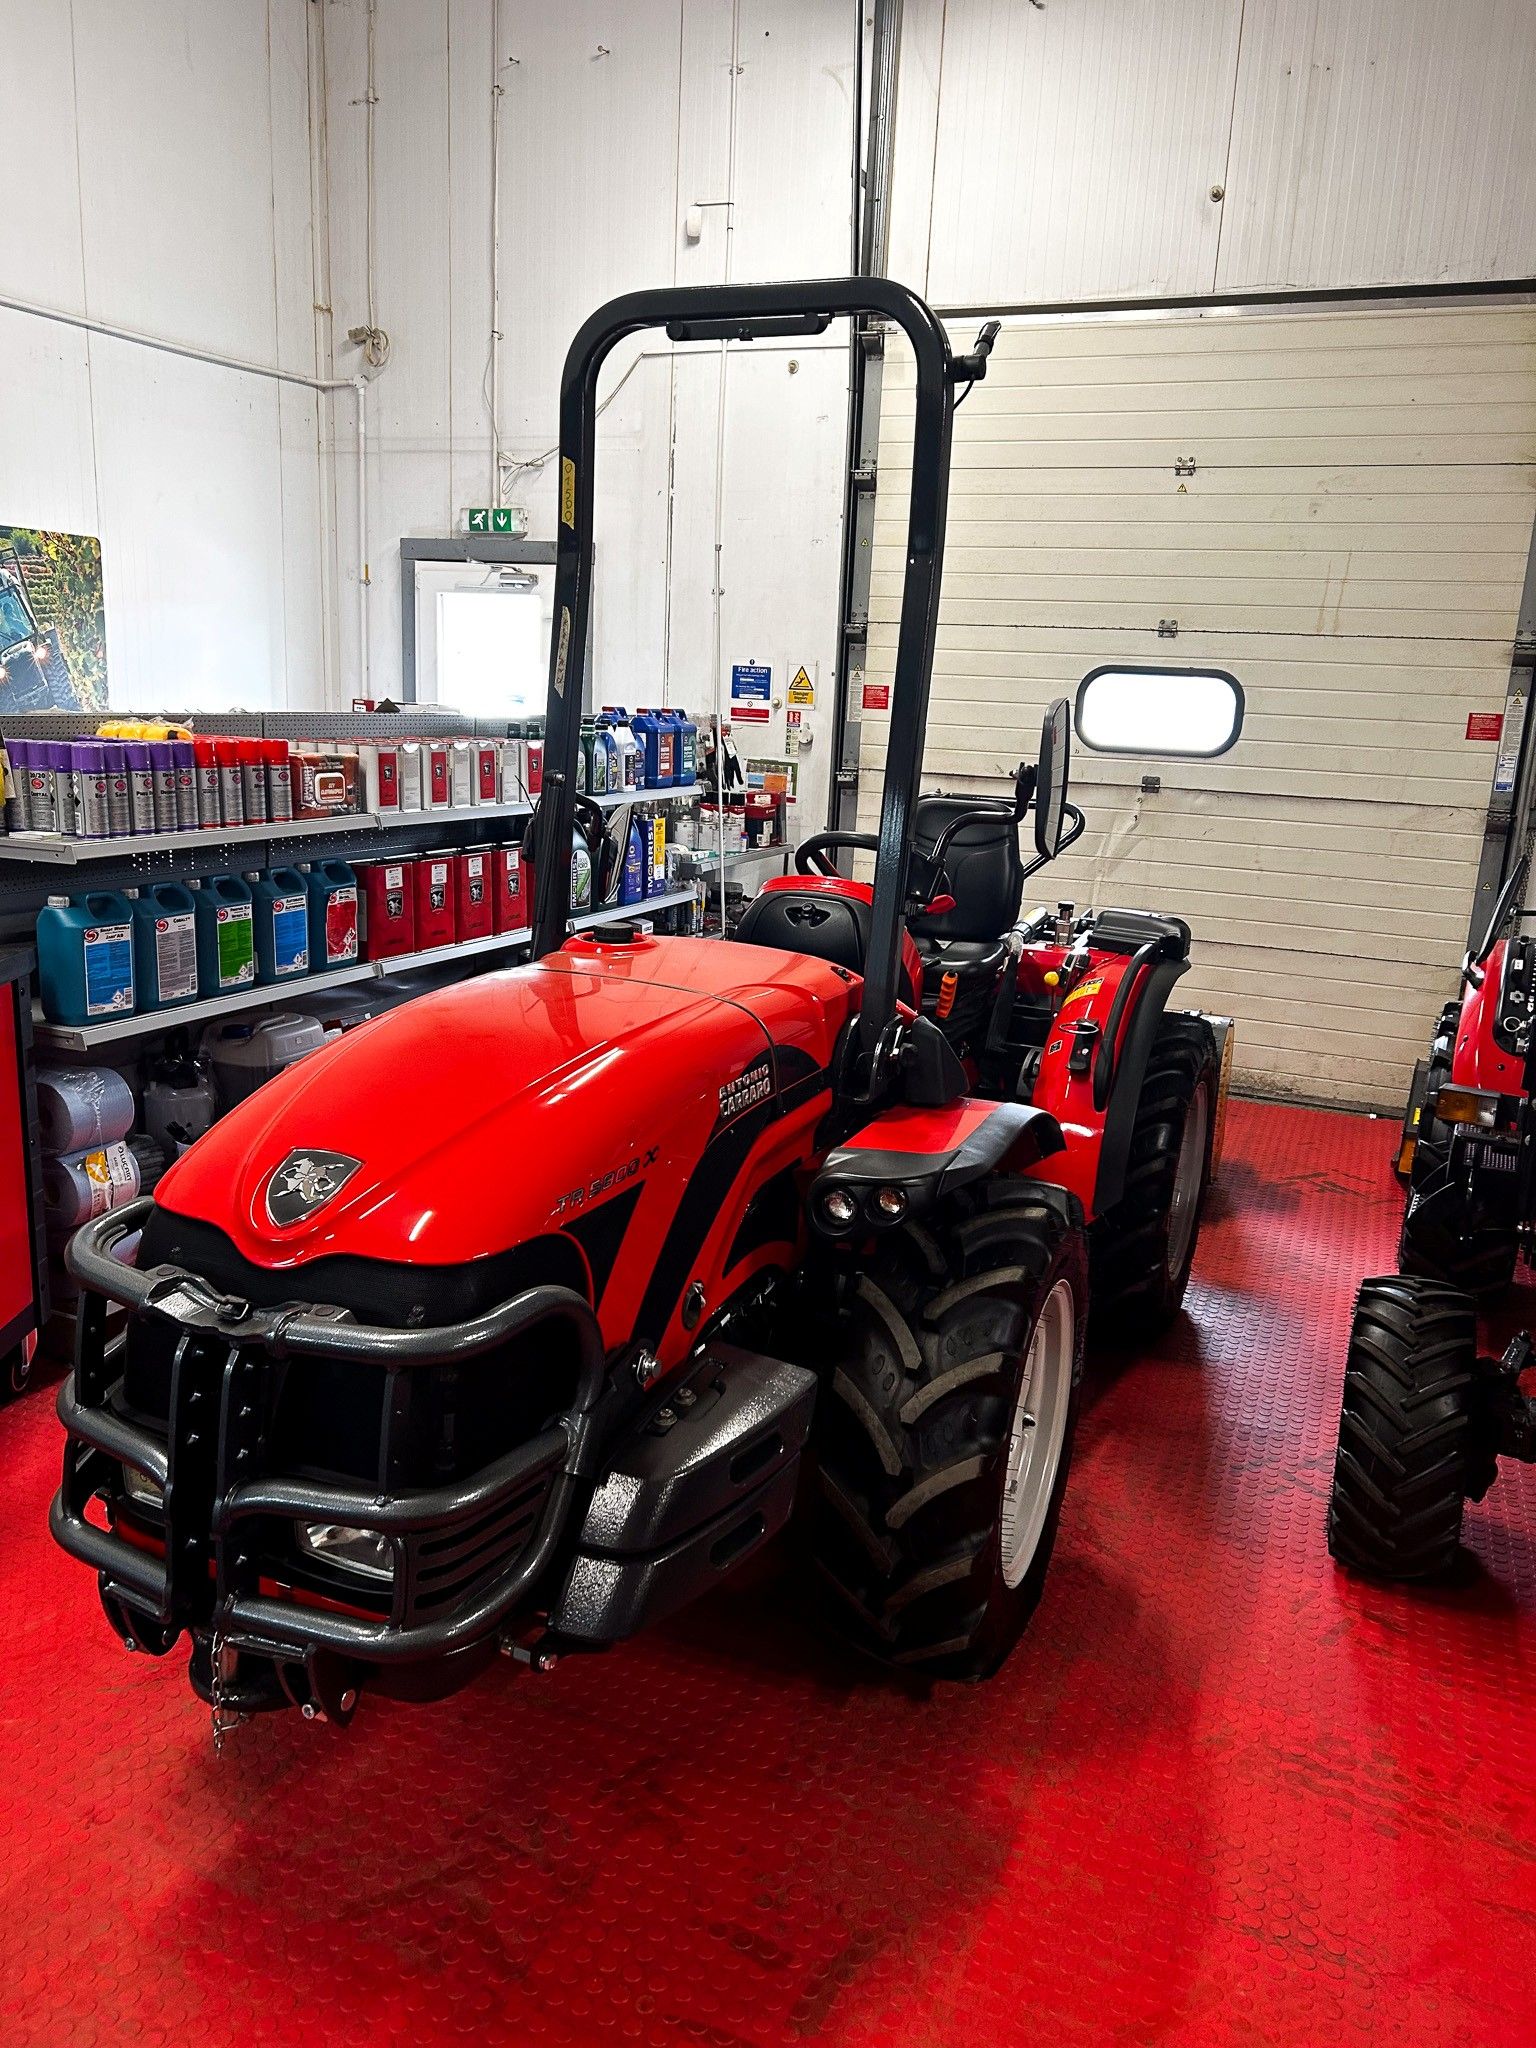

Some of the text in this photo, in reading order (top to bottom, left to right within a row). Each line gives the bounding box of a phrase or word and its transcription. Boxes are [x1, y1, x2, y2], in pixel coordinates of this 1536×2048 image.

[719, 1063, 769, 1099] ANTONIO
[719, 1077, 771, 1117] CARRARO
[557, 1188, 584, 1212] TR
[643, 1145, 660, 1169] X
